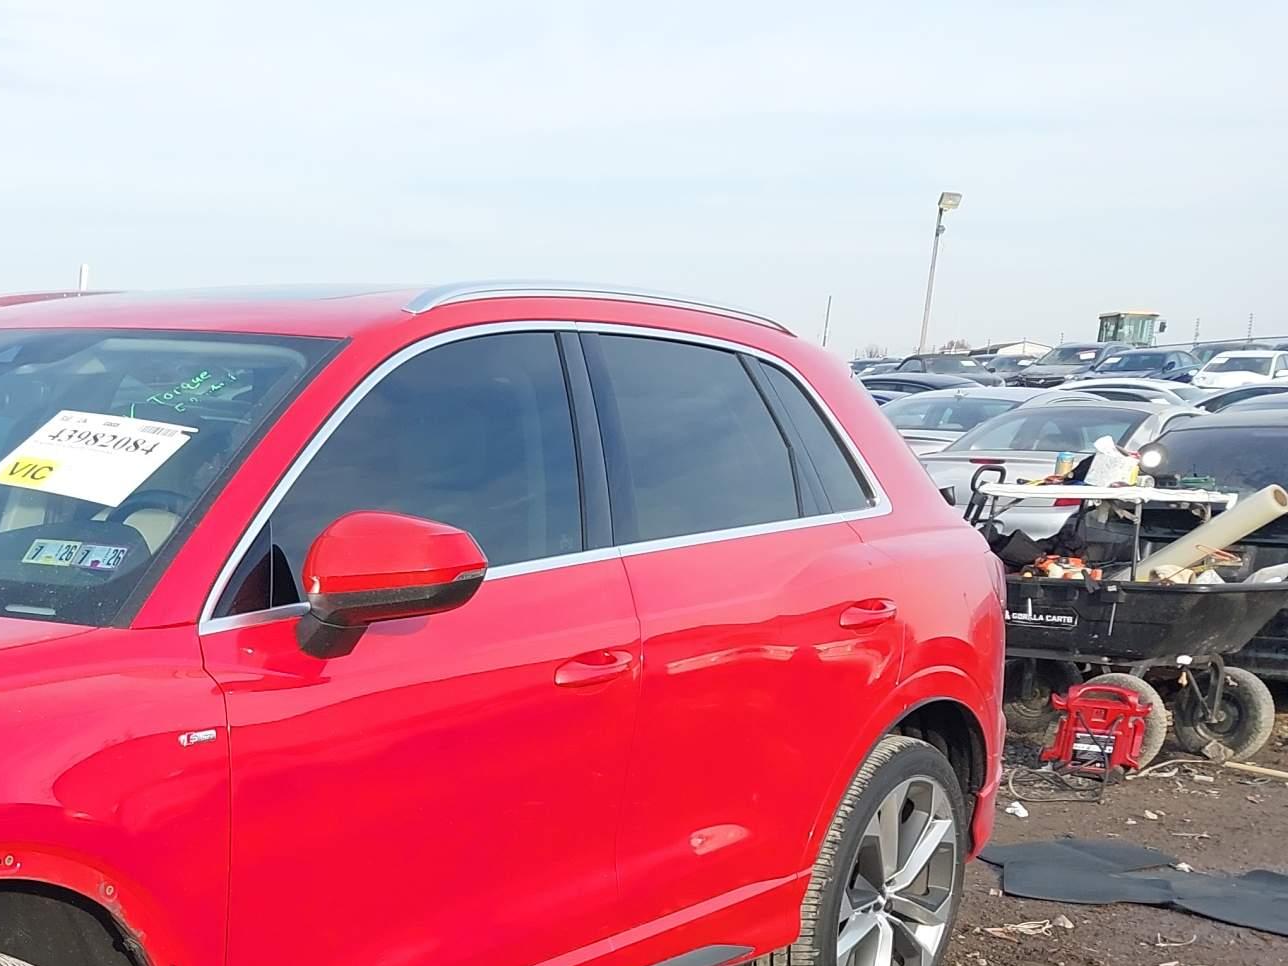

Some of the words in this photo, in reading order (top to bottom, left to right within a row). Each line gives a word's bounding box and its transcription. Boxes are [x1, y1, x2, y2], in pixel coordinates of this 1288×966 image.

[47, 427, 161, 456] 43982084
[8, 461, 54, 481] VIC
[1011, 612, 1044, 621] GORLLA
